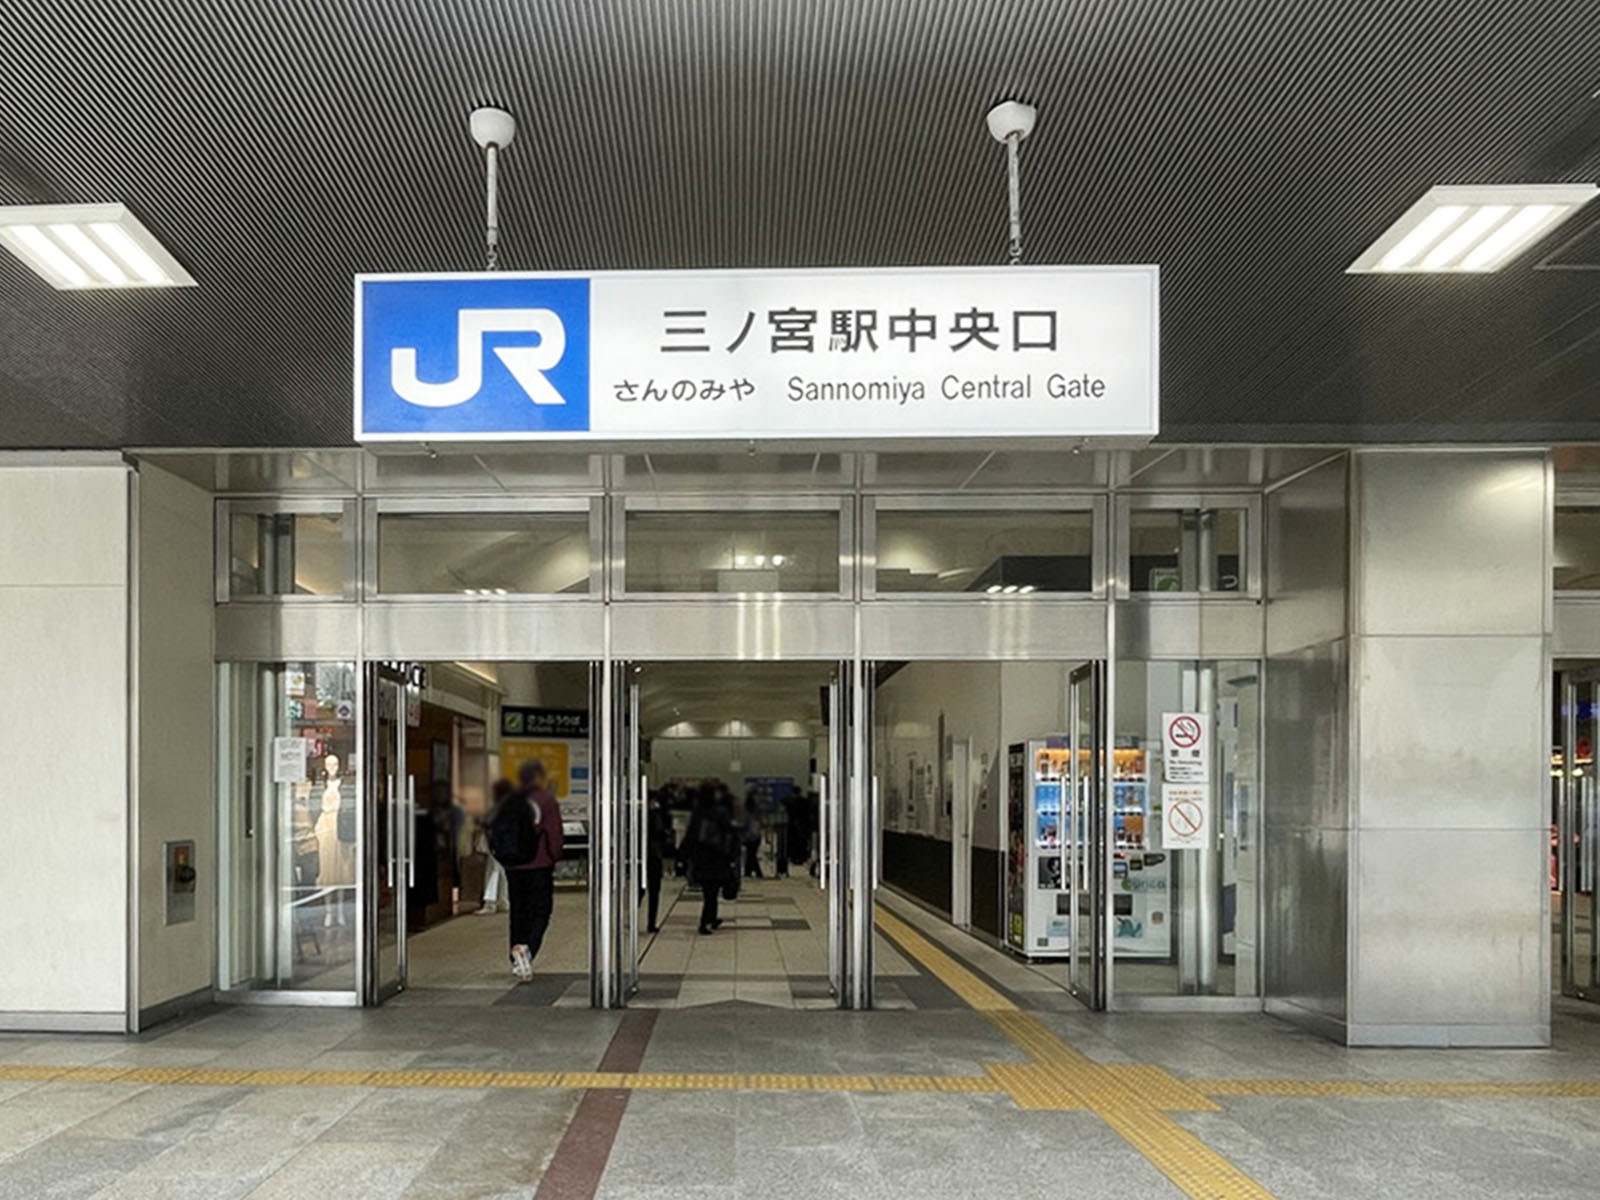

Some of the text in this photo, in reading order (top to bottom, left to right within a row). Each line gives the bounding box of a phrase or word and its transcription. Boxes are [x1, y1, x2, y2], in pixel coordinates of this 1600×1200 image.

[661, 307, 1057, 353] 三ノ宮駅中央口
[391, 308, 566, 407] JR
[614, 378, 755, 402] さんのみや
[789, 373, 1105, 405] Sannomiya Central Gate
